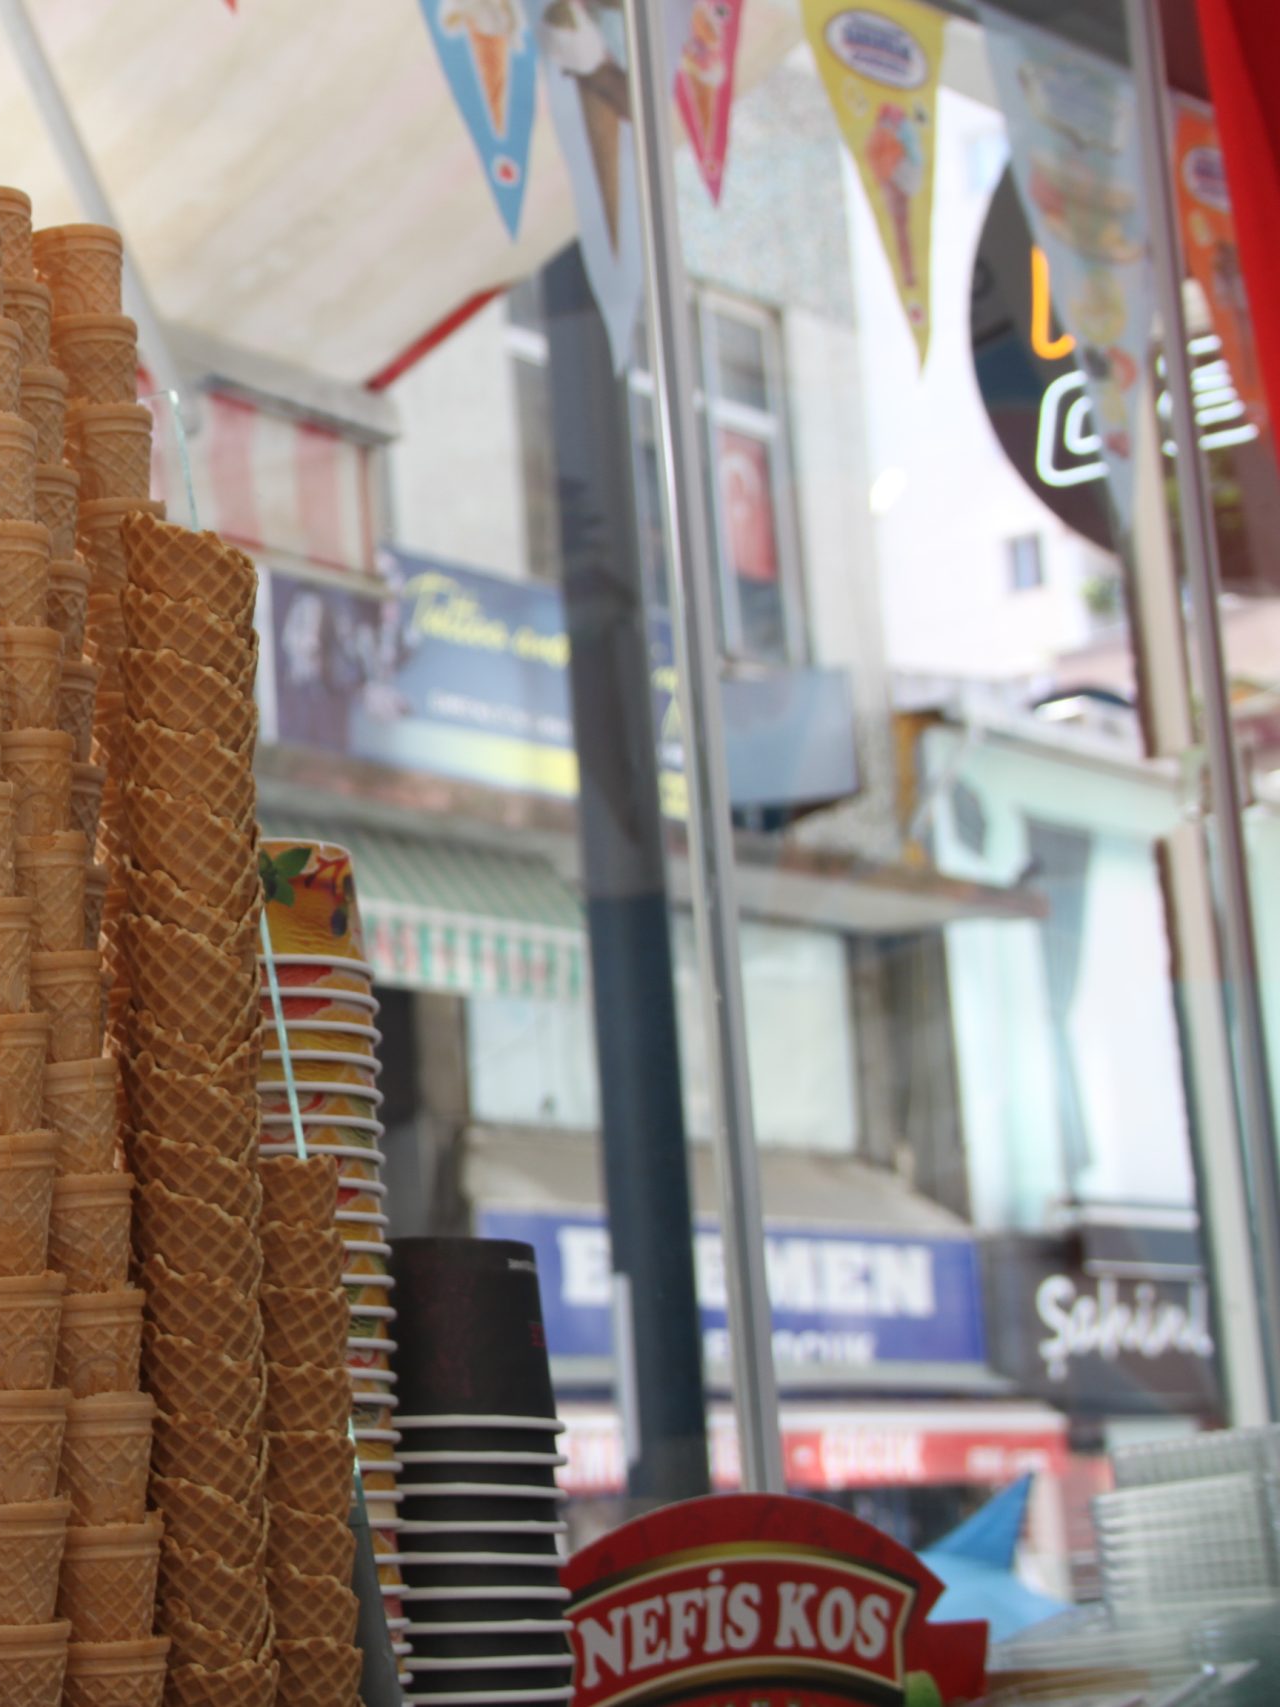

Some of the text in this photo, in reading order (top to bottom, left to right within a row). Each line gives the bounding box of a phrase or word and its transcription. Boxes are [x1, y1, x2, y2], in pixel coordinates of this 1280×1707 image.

[558, 1226, 936, 1318] EEMEN
[577, 1568, 890, 1688] NEFİS KOS
